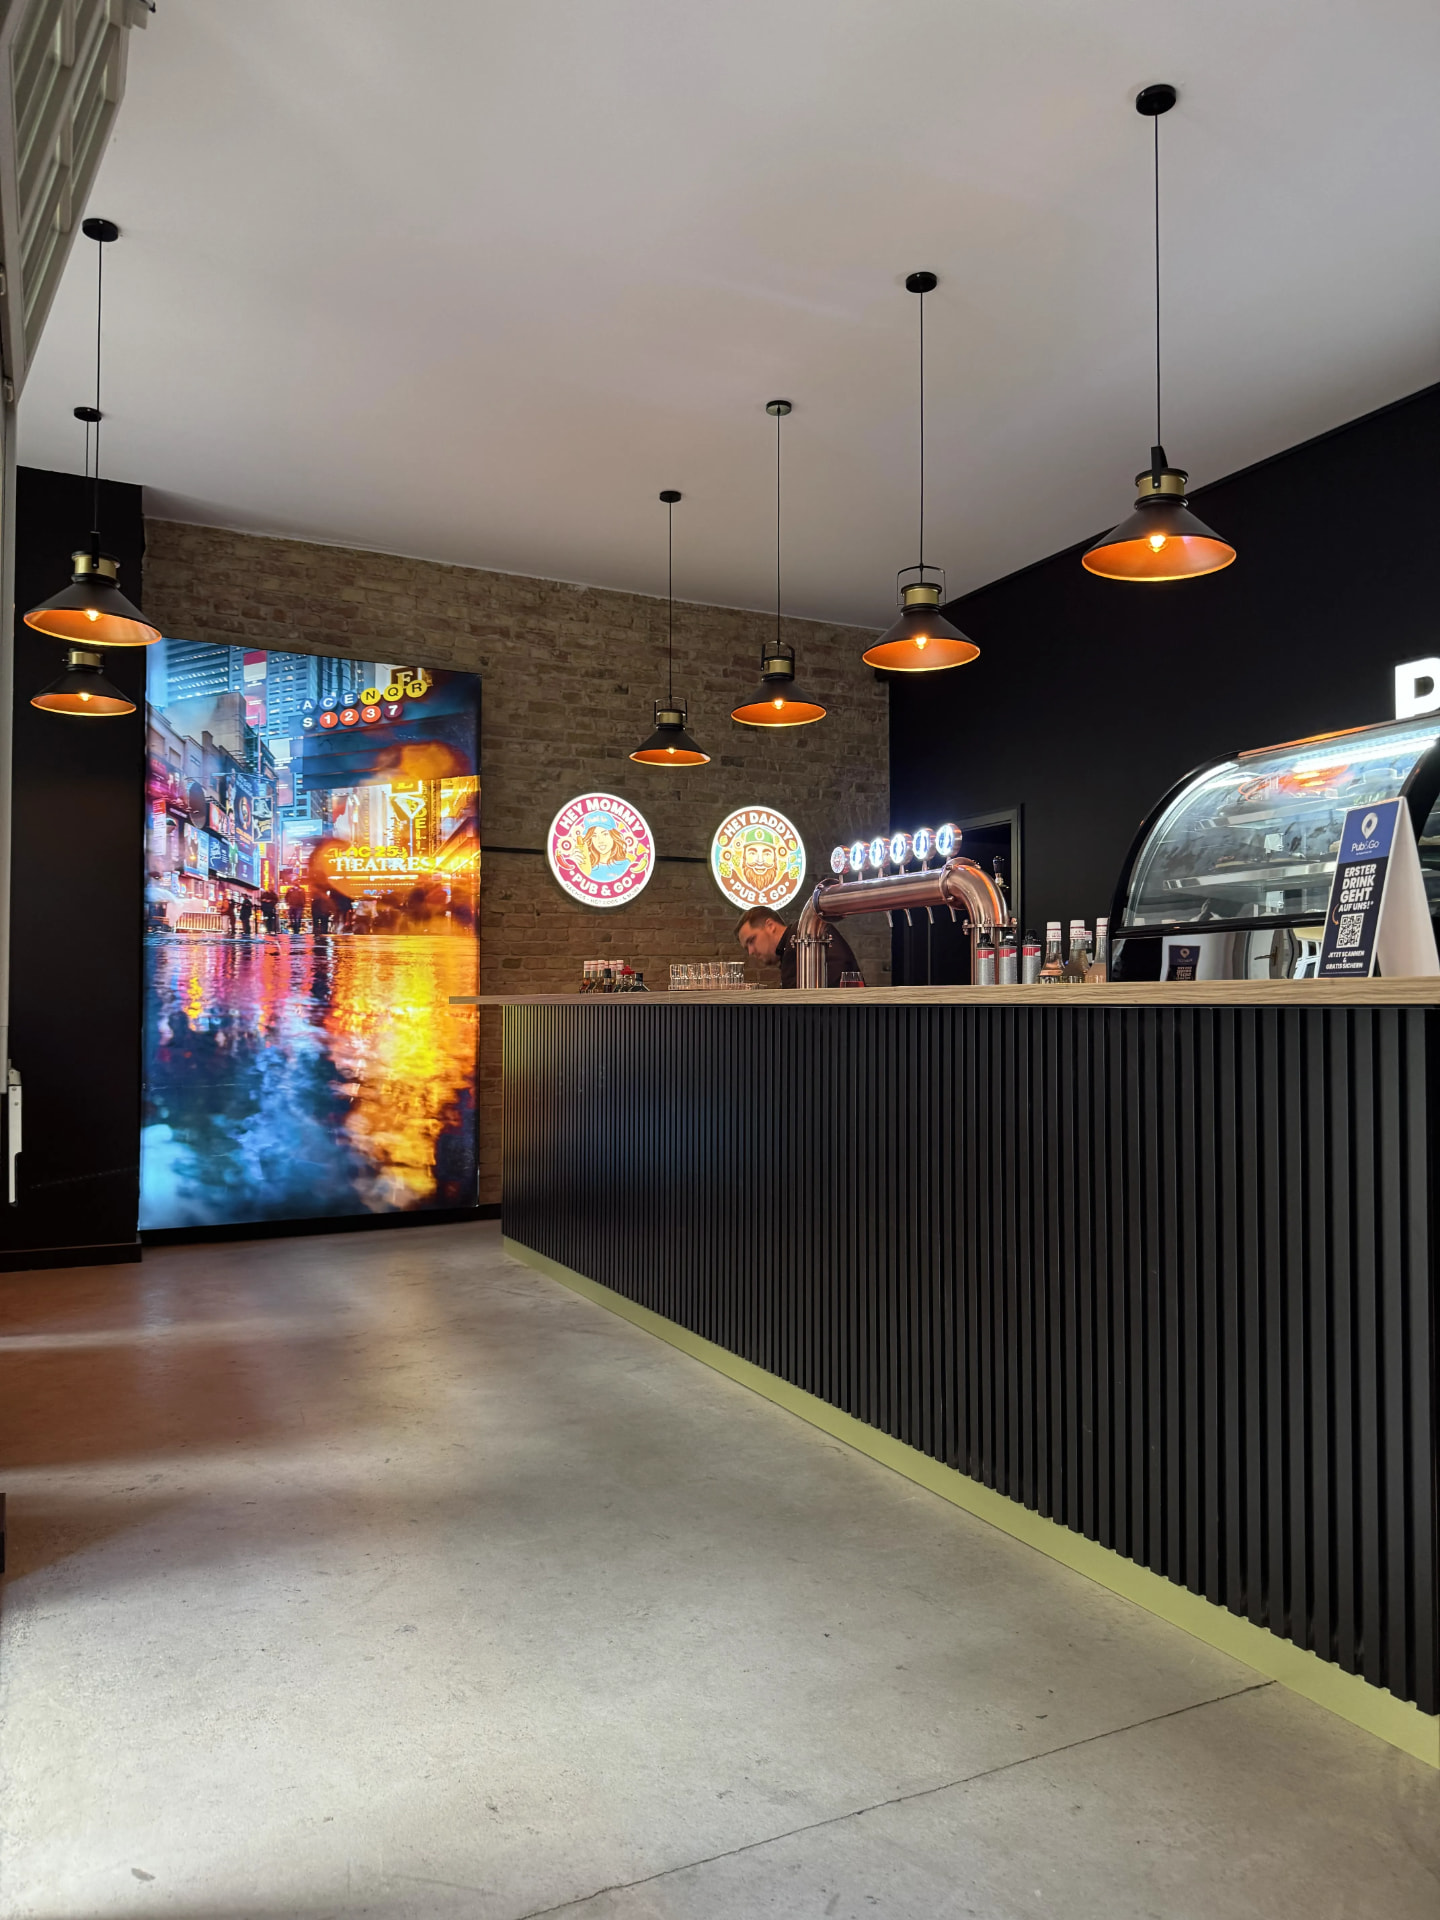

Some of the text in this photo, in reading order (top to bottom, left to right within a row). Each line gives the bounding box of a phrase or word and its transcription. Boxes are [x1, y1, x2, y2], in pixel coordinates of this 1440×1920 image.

[302, 682, 423, 710] A C E N Q R
[302, 717, 313, 728] S
[344, 711, 354, 721] 2
[366, 708, 376, 718] 3
[388, 705, 398, 715] 7
[559, 798, 643, 832] HEY MOMMY
[723, 812, 793, 840] HEY DADDY
[1342, 874, 1376, 890] DRINK
[1344, 863, 1377, 878] ERSTER
[571, 873, 633, 896] PUB & GO
[732, 881, 756, 902] PUB
[758, 892, 768, 904] &
[769, 884, 787, 900] GO
[1340, 887, 1373, 904] GEHT
[1338, 902, 1353, 913] AUF
